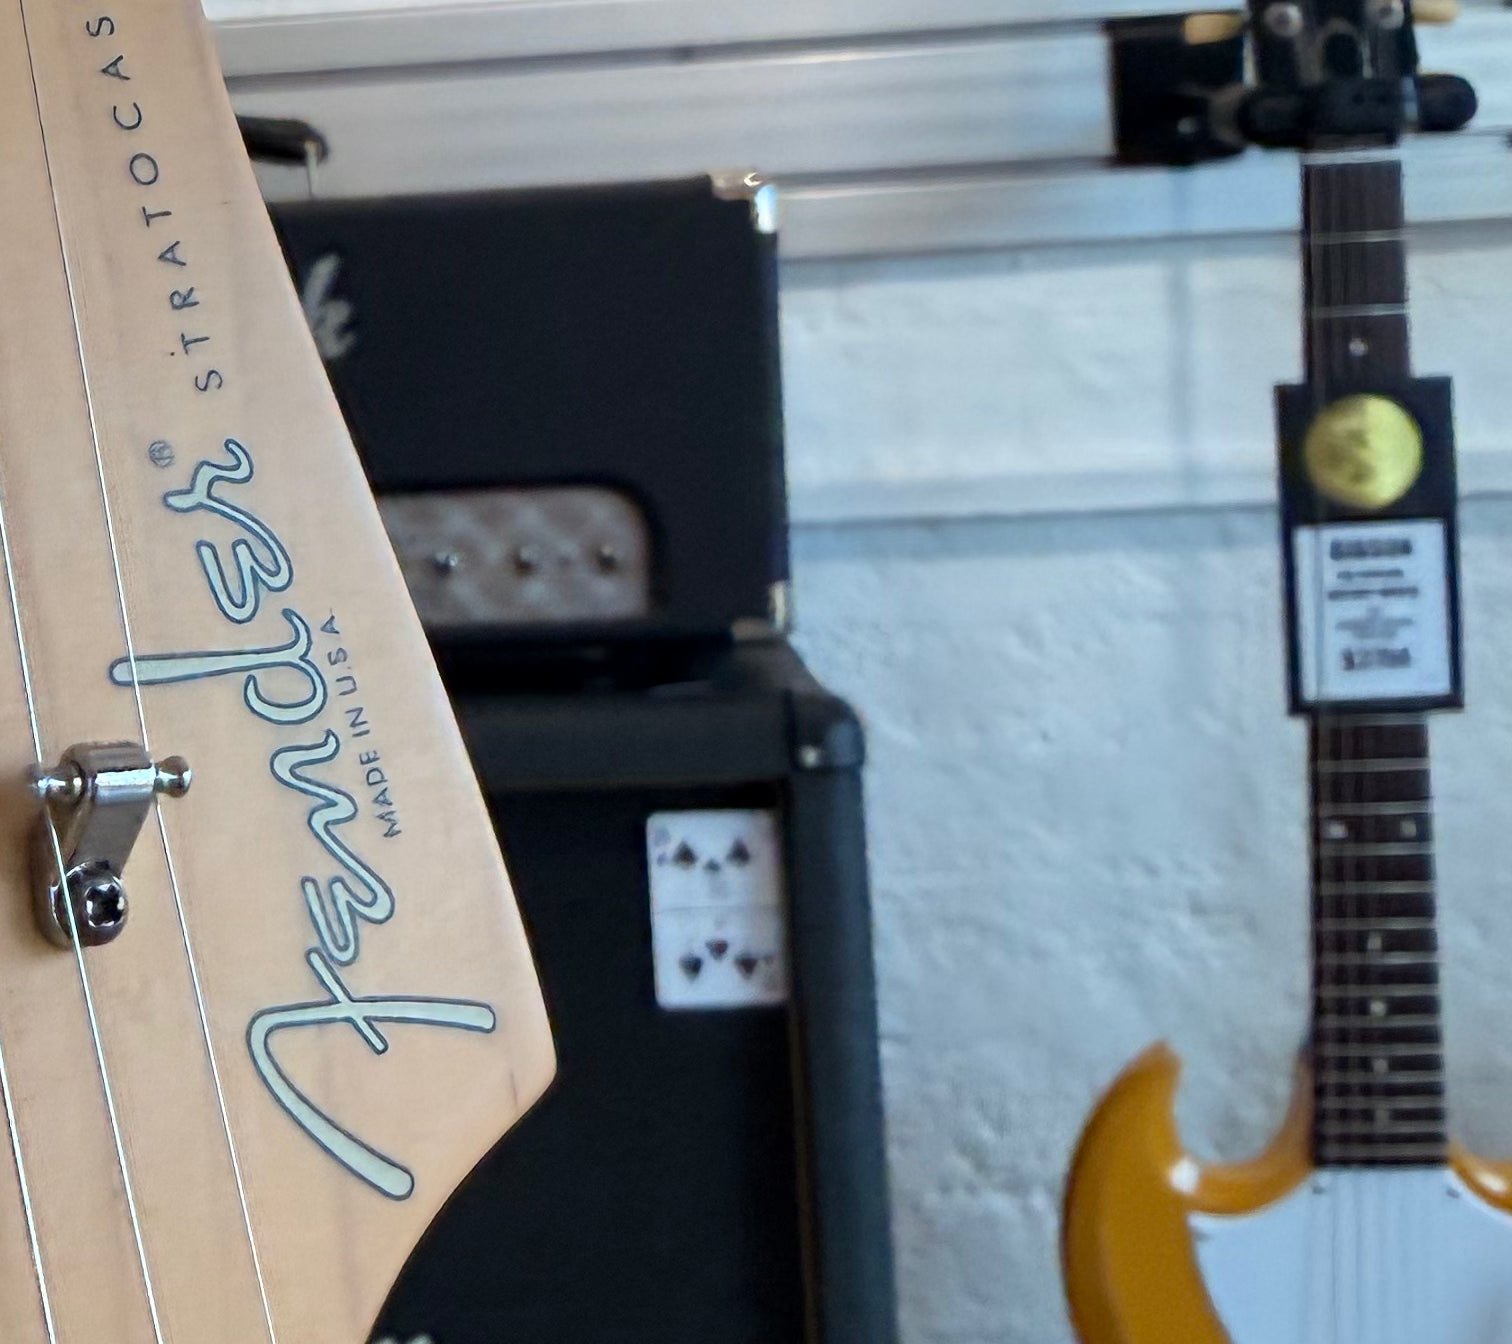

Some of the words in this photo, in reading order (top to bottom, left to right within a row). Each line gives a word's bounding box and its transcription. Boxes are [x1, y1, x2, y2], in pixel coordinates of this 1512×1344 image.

[344, 706, 370, 738] IN
[109, 438, 497, 1203] Fender
[359, 749, 402, 838] MADE
